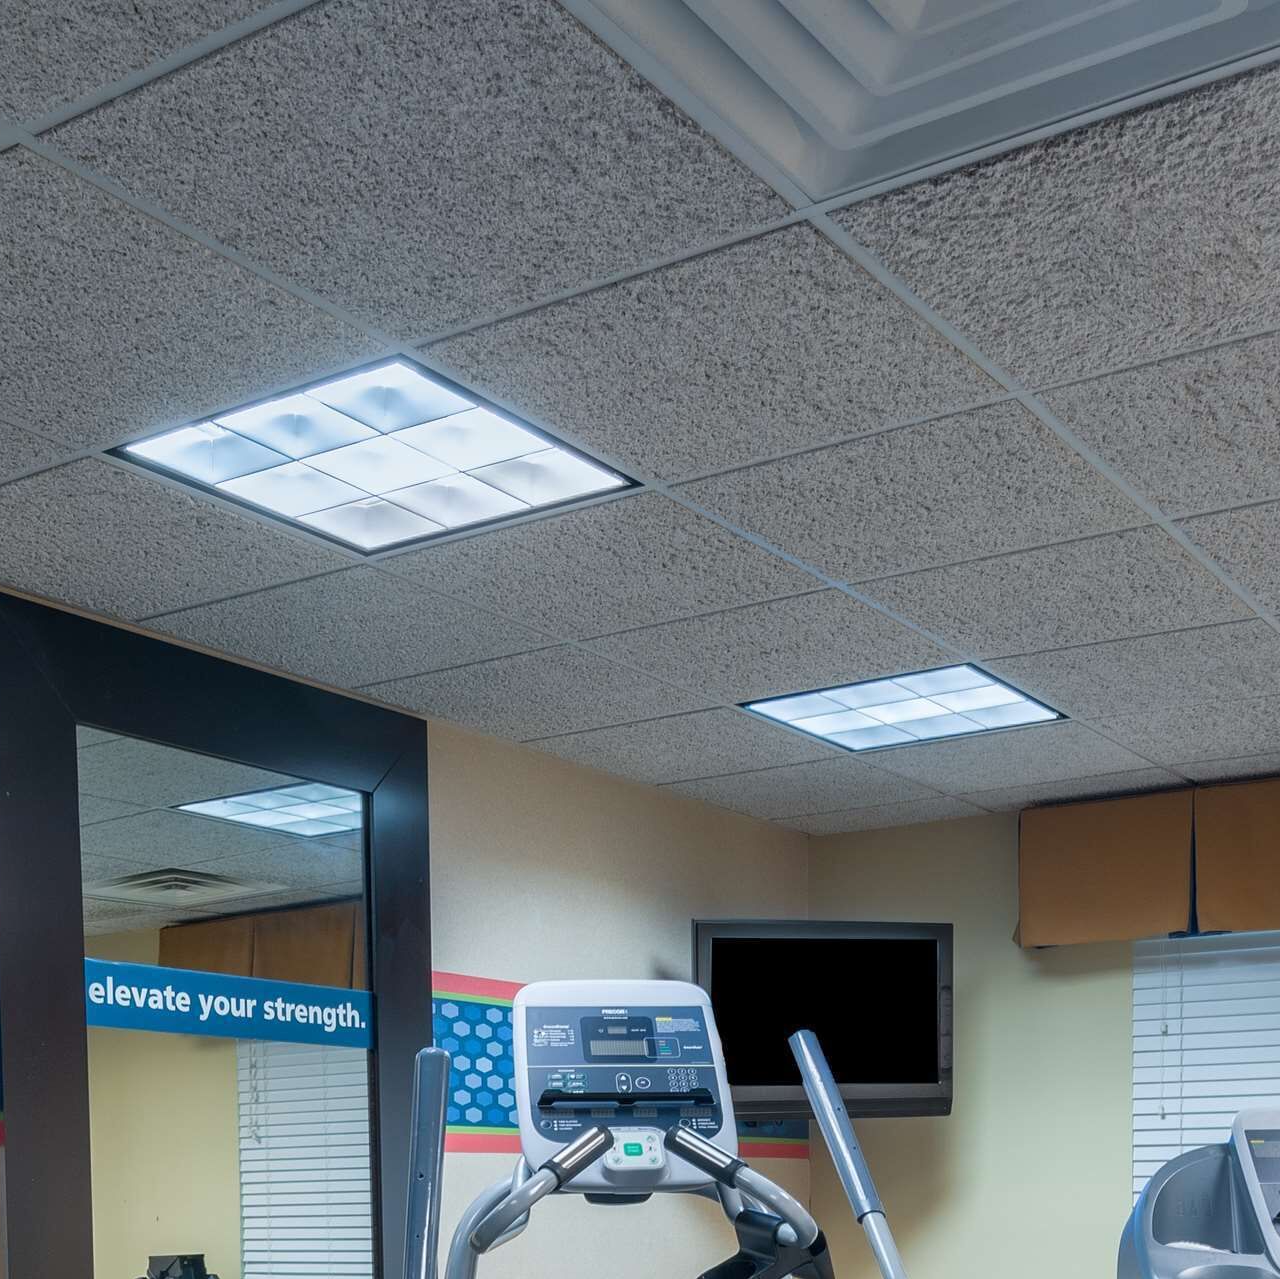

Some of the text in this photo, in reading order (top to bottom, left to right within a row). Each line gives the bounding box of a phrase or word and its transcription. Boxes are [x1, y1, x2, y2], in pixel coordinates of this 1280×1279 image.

[88, 976, 366, 1032] elevate your strength.
